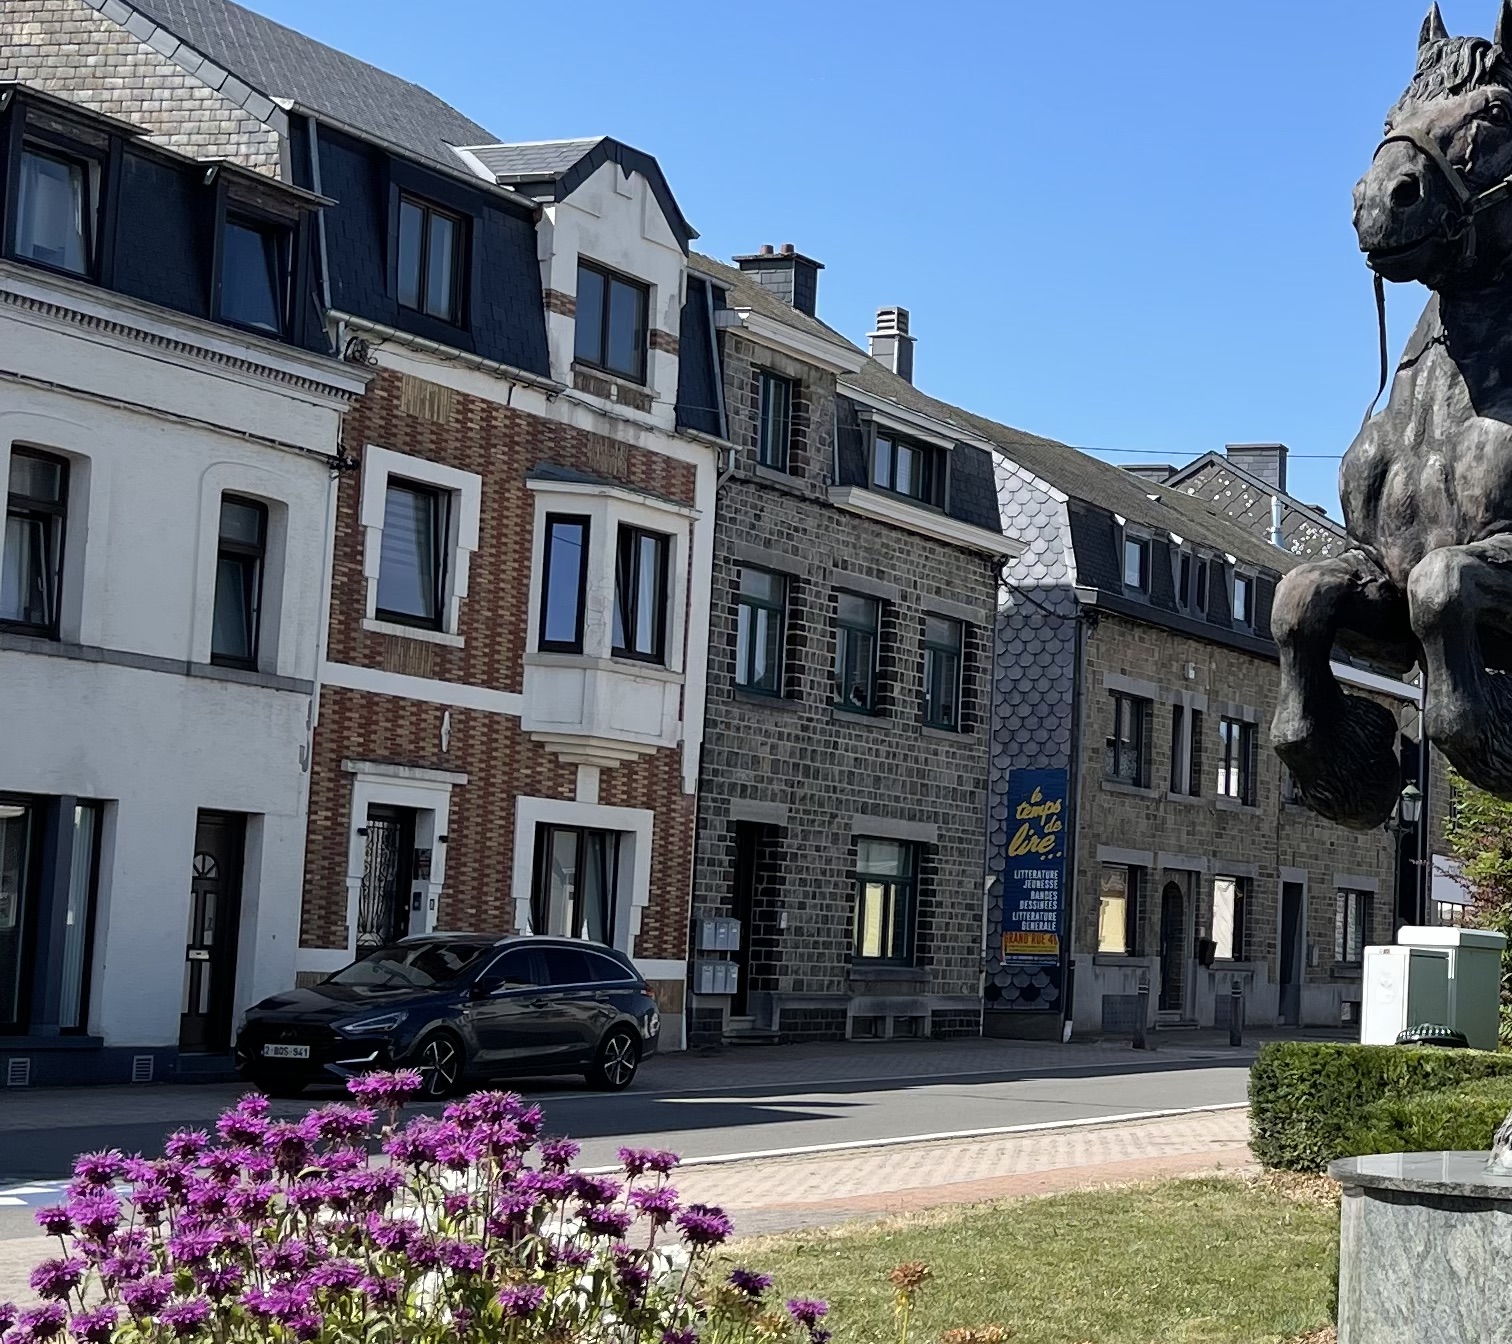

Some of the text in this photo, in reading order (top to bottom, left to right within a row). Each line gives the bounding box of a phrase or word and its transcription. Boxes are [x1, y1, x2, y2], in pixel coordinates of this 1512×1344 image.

[1016, 799, 1062, 826] temps
[1044, 815, 1062, 833] de
[1023, 879, 1058, 889] JEUNESSE
[1030, 890, 1058, 900] BANDES
